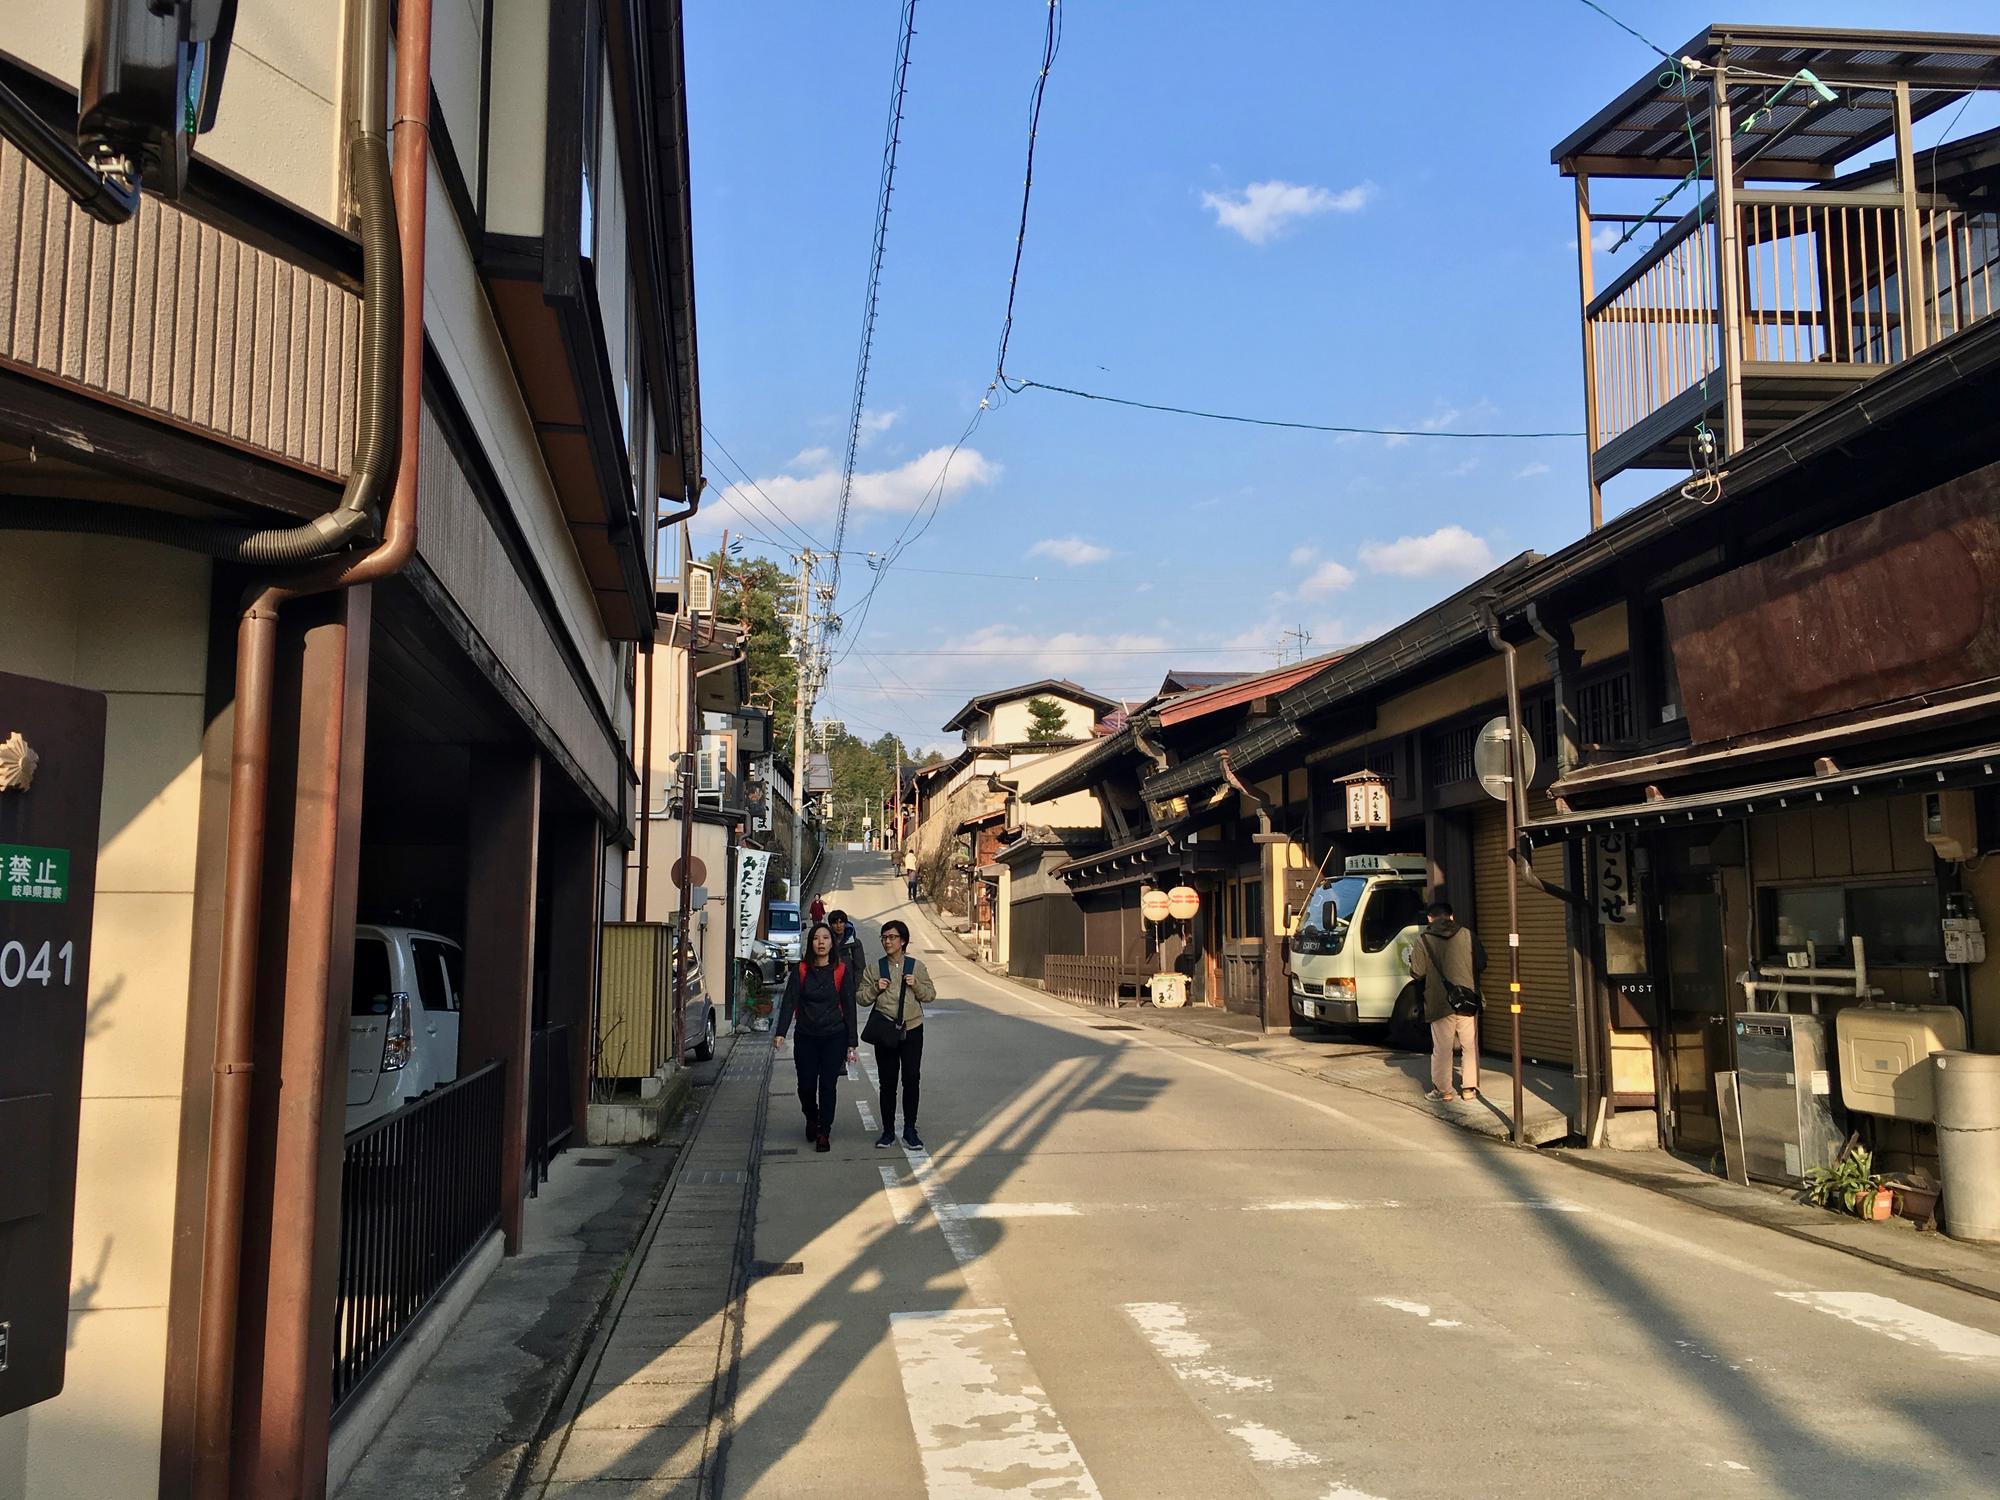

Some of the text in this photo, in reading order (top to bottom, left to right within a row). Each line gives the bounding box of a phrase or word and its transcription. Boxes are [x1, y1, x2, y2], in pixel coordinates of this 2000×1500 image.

[0, 854, 57, 884] 禁止
[1600, 833, 1626, 923] むらせ
[11, 884, 62, 899] 岐阜県警察
[0, 940, 73, 988] 041
[1621, 985, 1653, 993] POST
